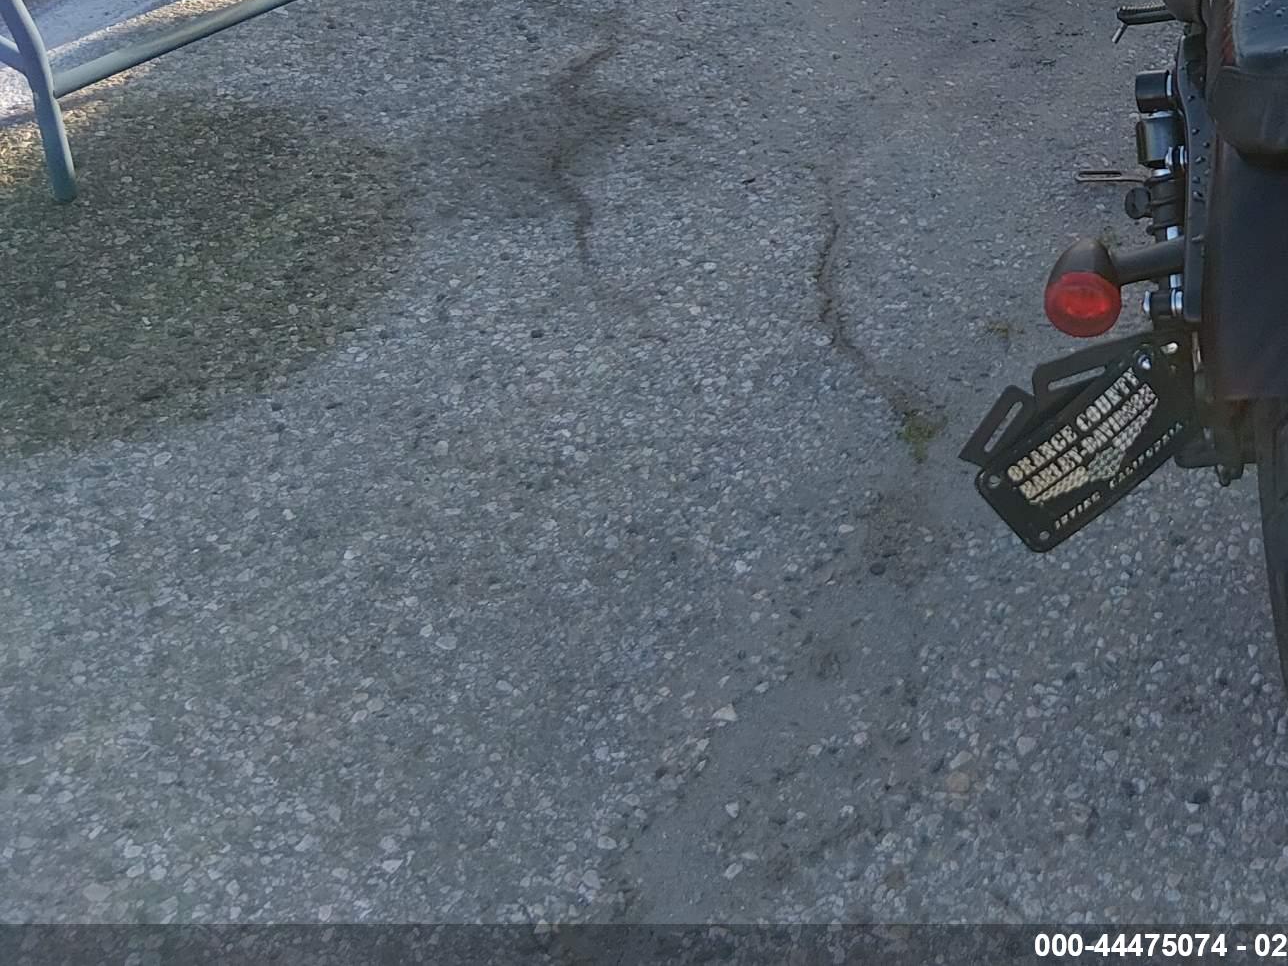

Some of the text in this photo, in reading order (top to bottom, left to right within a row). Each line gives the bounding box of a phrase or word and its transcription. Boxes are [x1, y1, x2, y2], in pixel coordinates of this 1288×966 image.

[1008, 367, 1139, 482] ORANGE COUNTY
[1019, 384, 1157, 500] HARLEY-DAVIDSON
